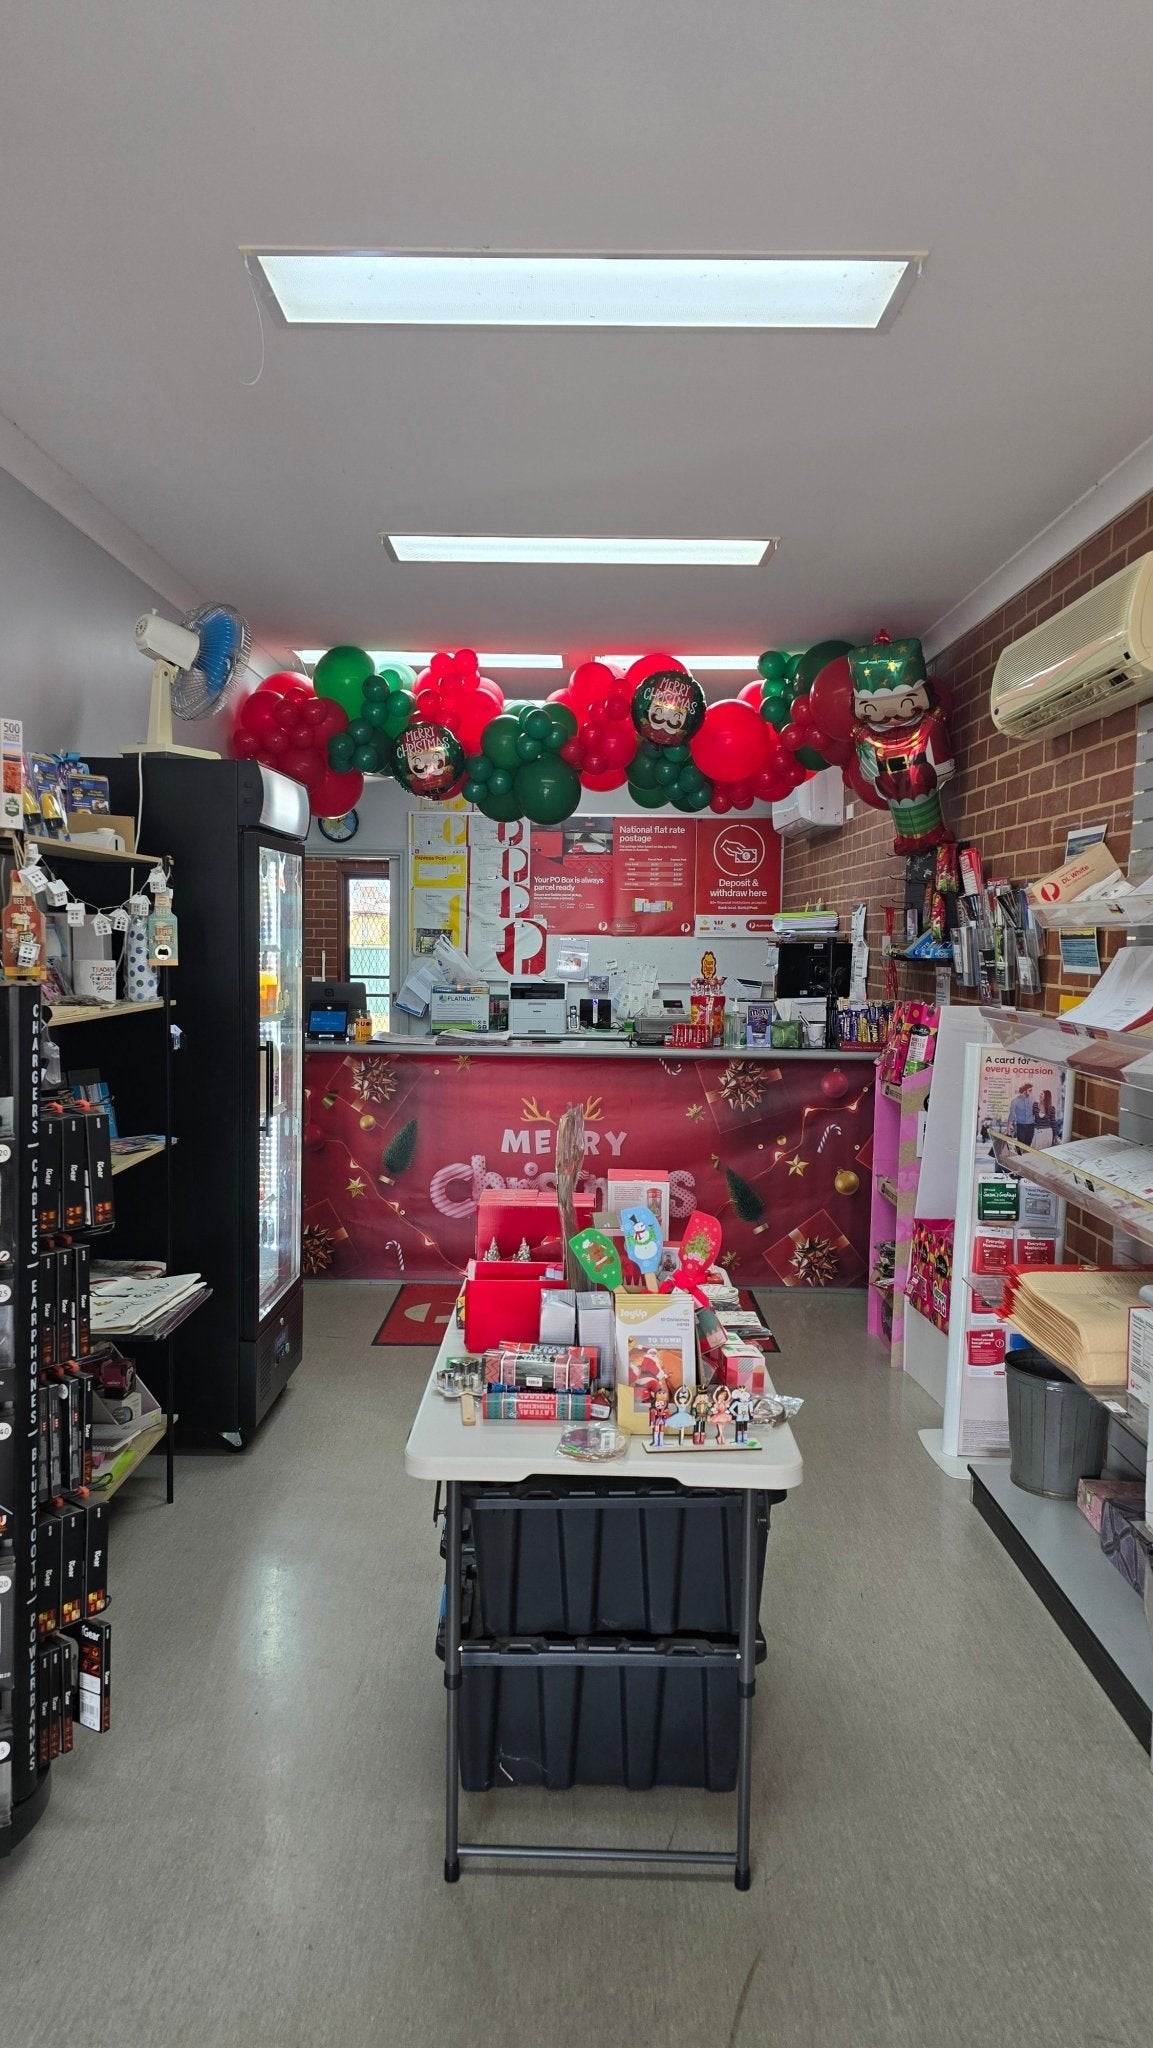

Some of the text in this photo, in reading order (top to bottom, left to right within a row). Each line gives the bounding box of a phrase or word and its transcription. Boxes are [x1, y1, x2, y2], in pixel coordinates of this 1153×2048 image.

[660, 677, 691, 697] MERRY
[643, 687, 698, 715] CHRISTMAS
[3, 722, 20, 734] 500
[405, 726, 435, 742] MERRY
[396, 736, 450, 759] CHRISTMAS
[619, 825, 686, 834] National flat rate
[619, 834, 652, 844] postage
[1071, 864, 1090, 880] White
[533, 876, 604, 885] Your PO Box is always
[556, 884, 576, 892] ready
[718, 879, 759, 888] Deposit &
[709, 888, 768, 897] withdraw here
[985, 1055, 1031, 1065] A card for
[31, 1003, 39, 1135] CHARGERS
[985, 1066, 1053, 1075] every occasion
[500, 1128, 628, 1157] MERY
[31, 1158, 39, 1255] CABLES
[620, 1308, 648, 1320] JoyUp
[30, 1279, 38, 1424] EARPHONES
[30, 1447, 38, 1591] BLUETOOTH
[81, 1624, 101, 1642] iGear
